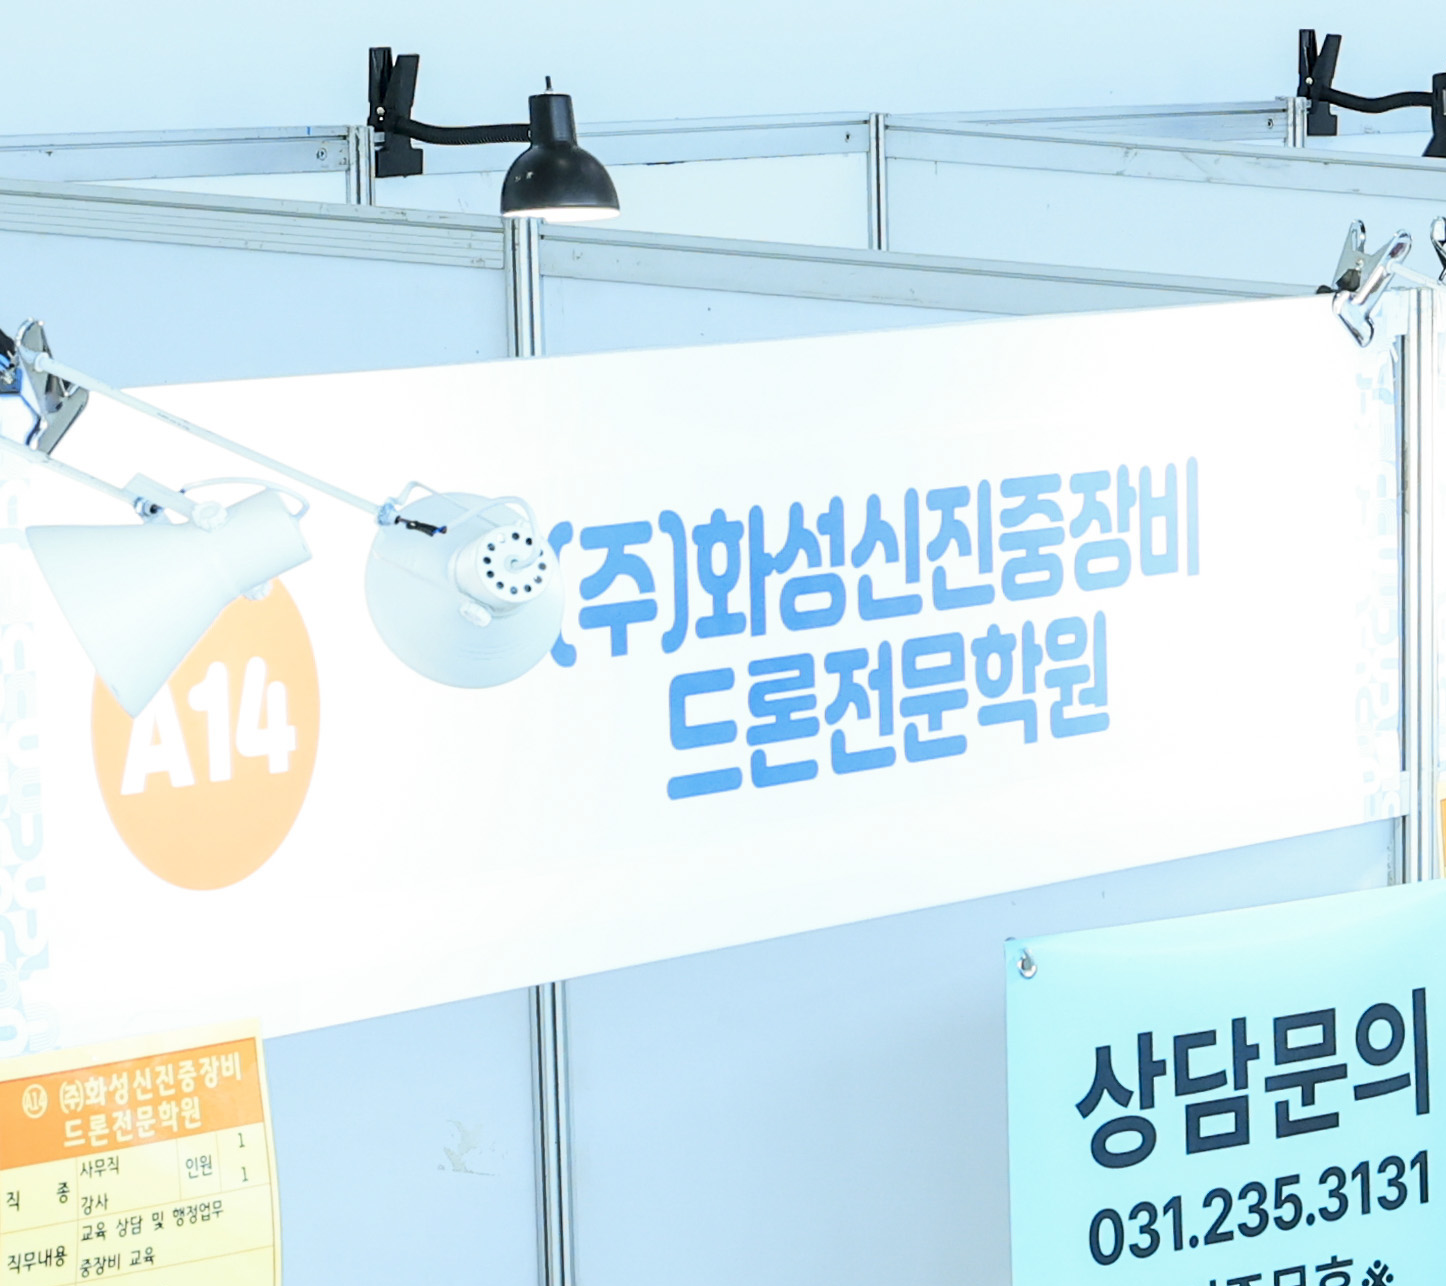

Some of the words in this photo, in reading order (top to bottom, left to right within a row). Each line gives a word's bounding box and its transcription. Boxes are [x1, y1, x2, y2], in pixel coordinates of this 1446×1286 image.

[120, 658, 298, 796] A14
[666, 611, 1111, 801] 드론전문학원
[1075, 986, 1431, 1169] 상담문의
[63, 1096, 202, 1147] 드론전문학원
[80, 1156, 120, 1179] 사무직
[185, 1154, 214, 1180] 인원
[81, 1193, 109, 1216] 강사
[81, 1223, 107, 1242] 교육
[116, 1215, 144, 1238] 상담
[173, 1200, 224, 1225] 행정업무
[1088, 1149, 1431, 1267] 031.235.3131
[7, 1245, 68, 1274] 직무내용
[79, 1253, 121, 1278] 중장비
[129, 1247, 156, 1267] 교육
